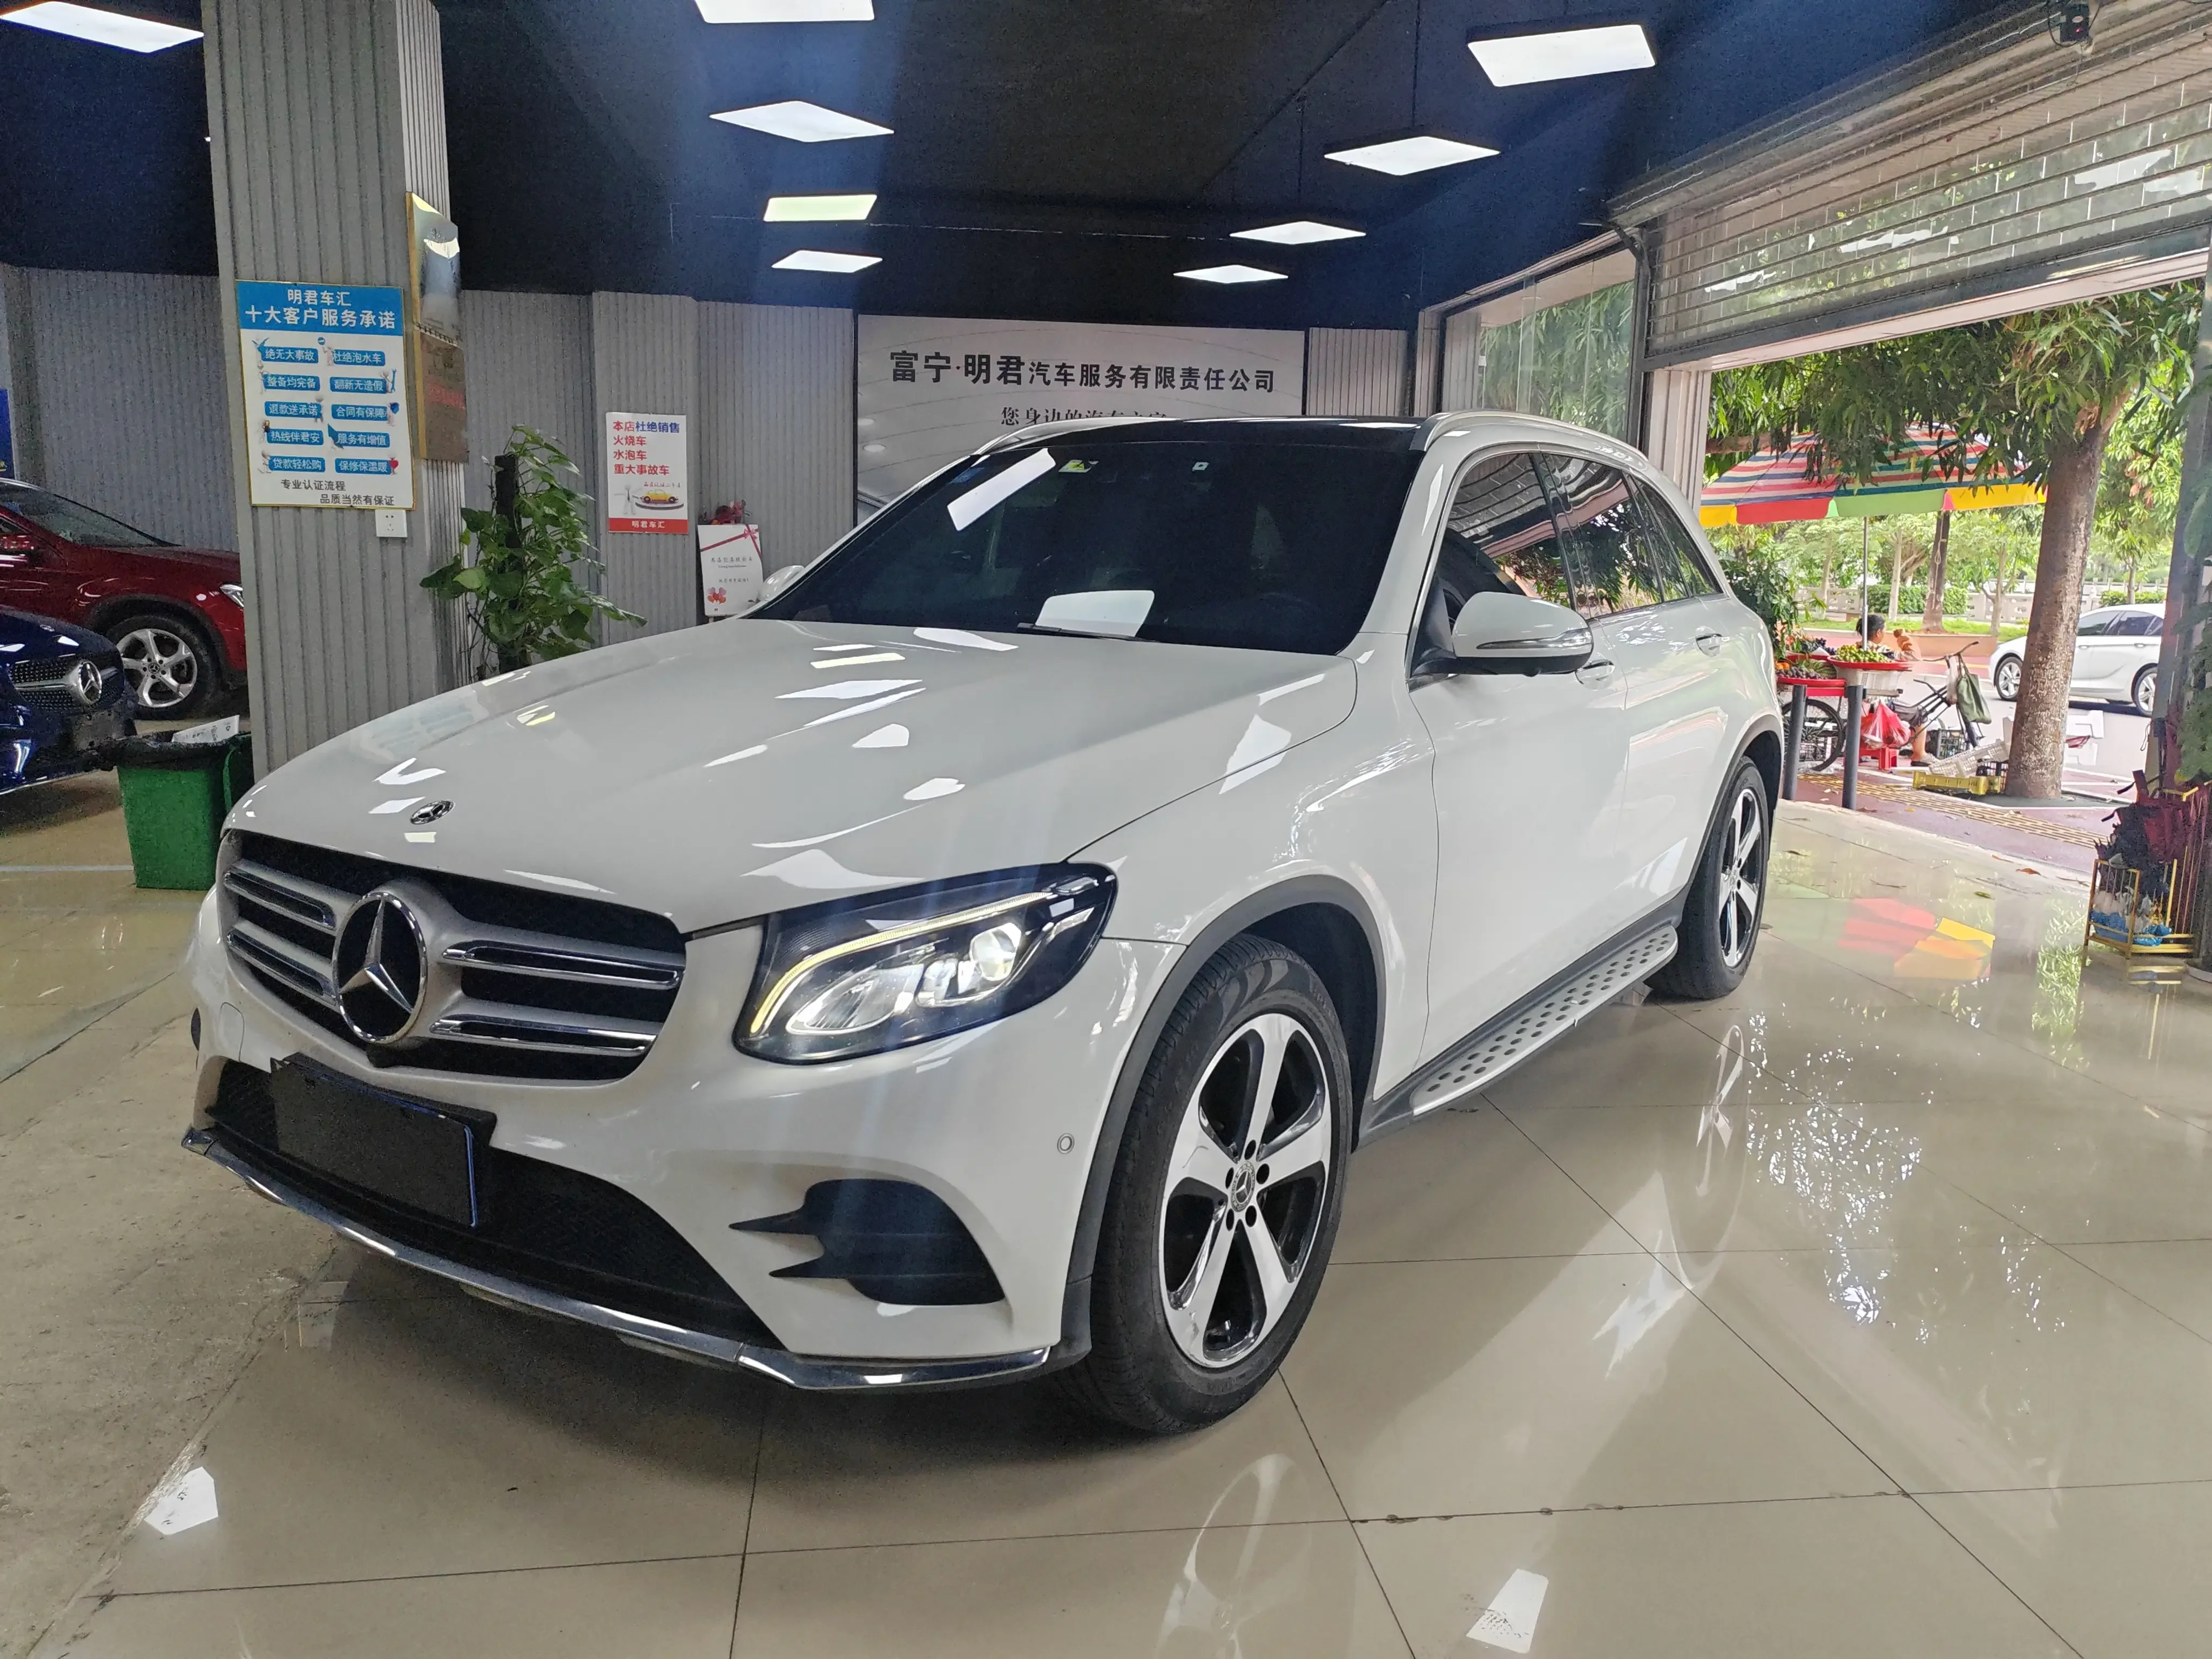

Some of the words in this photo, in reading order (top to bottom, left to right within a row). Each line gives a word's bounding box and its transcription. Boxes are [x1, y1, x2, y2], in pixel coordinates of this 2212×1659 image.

[287, 289, 351, 306] 明君车汇
[245, 305, 395, 329] 十大客户服务承诺
[265, 348, 315, 361] 绝无大事故
[334, 350, 382, 363] 杜绝泡水车
[889, 350, 1274, 393] 富宁·明君汽车服务有限责任公司
[267, 375, 316, 388] 整备均完备
[334, 379, 383, 391] 翻新无造假
[269, 402, 318, 415] 退款送承诺
[336, 406, 386, 418] 合同有保障
[1001, 406, 1167, 426] 您身边的
[613, 420, 680, 433] 本店杜绝销售
[271, 431, 321, 443] 热线伴君安
[335, 433, 387, 445] 服务有增值
[613, 435, 647, 446] 火烧车
[613, 449, 648, 461] 水泡车
[273, 458, 322, 470] 贷款轻松购
[339, 461, 388, 473] 保修保温暖
[613, 463, 670, 476] 重大事故车
[280, 478, 346, 491] 专业认证流程
[320, 494, 395, 507] 品质当然有保证
[631, 520, 665, 529] 明君车汇
